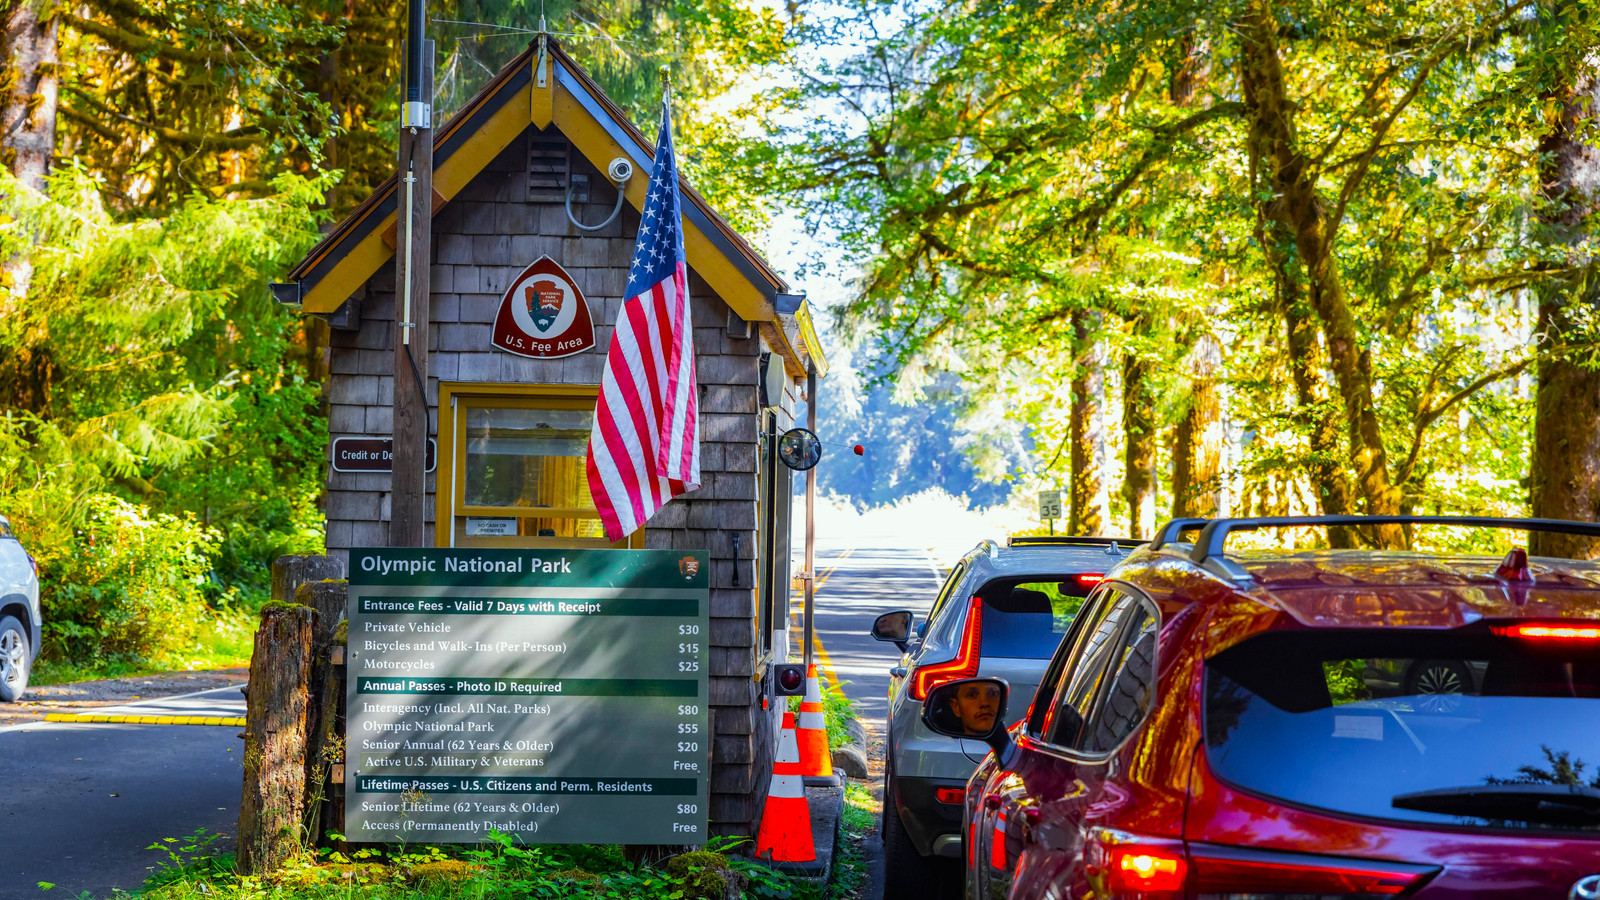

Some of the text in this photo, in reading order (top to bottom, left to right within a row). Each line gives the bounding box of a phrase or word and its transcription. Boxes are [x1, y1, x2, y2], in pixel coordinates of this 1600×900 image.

[505, 335, 583, 351] U.S. Fee Area
[342, 450, 367, 460] Credit
[370, 452, 379, 460] or
[1042, 505, 1059, 516] 35
[361, 556, 572, 574] Olympic National Park
[364, 601, 414, 610] Entrance
[418, 601, 443, 611] Fees
[454, 601, 482, 611] Valid
[487, 602, 493, 611] 7
[497, 602, 525, 613] Days
[528, 601, 555, 612] with
[558, 602, 601, 614] Receipt
[364, 622, 451, 633] Private Vehicle
[678, 624, 699, 636] $30
[364, 640, 566, 653] Bicycles and Walk- Ins (Per Person)
[678, 642, 699, 654] $15
[364, 658, 435, 671] Motorcycles
[678, 660, 699, 672] $25
[364, 681, 405, 691] Annual
[409, 681, 445, 691] Passes
[457, 682, 491, 692] Photo
[494, 682, 506, 692] ID
[510, 682, 562, 694] Required
[364, 702, 550, 715] Interagency (Incl. All Nat. Parks)
[678, 704, 698, 716] $80
[363, 721, 494, 733] Olympic National Park
[678, 723, 698, 734] $55
[363, 740, 554, 752] Senior Annual (62 Years & Older)
[678, 741, 698, 753] $20
[365, 756, 544, 768] Active U.S. Military & Veterans
[674, 761, 698, 771] Free
[362, 780, 409, 790] Lifetime
[413, 781, 449, 791] Passes
[460, 781, 482, 791] U.S.
[487, 781, 532, 791] Citizens
[535, 781, 557, 792] and
[561, 781, 593, 792] Perm.
[597, 782, 653, 792] Residents
[362, 802, 560, 814] Senior Lifetime (62 Years & Older)
[677, 803, 697, 815] $80
[362, 820, 538, 833] Access (Permanently Disabled)
[673, 823, 697, 832] Free
